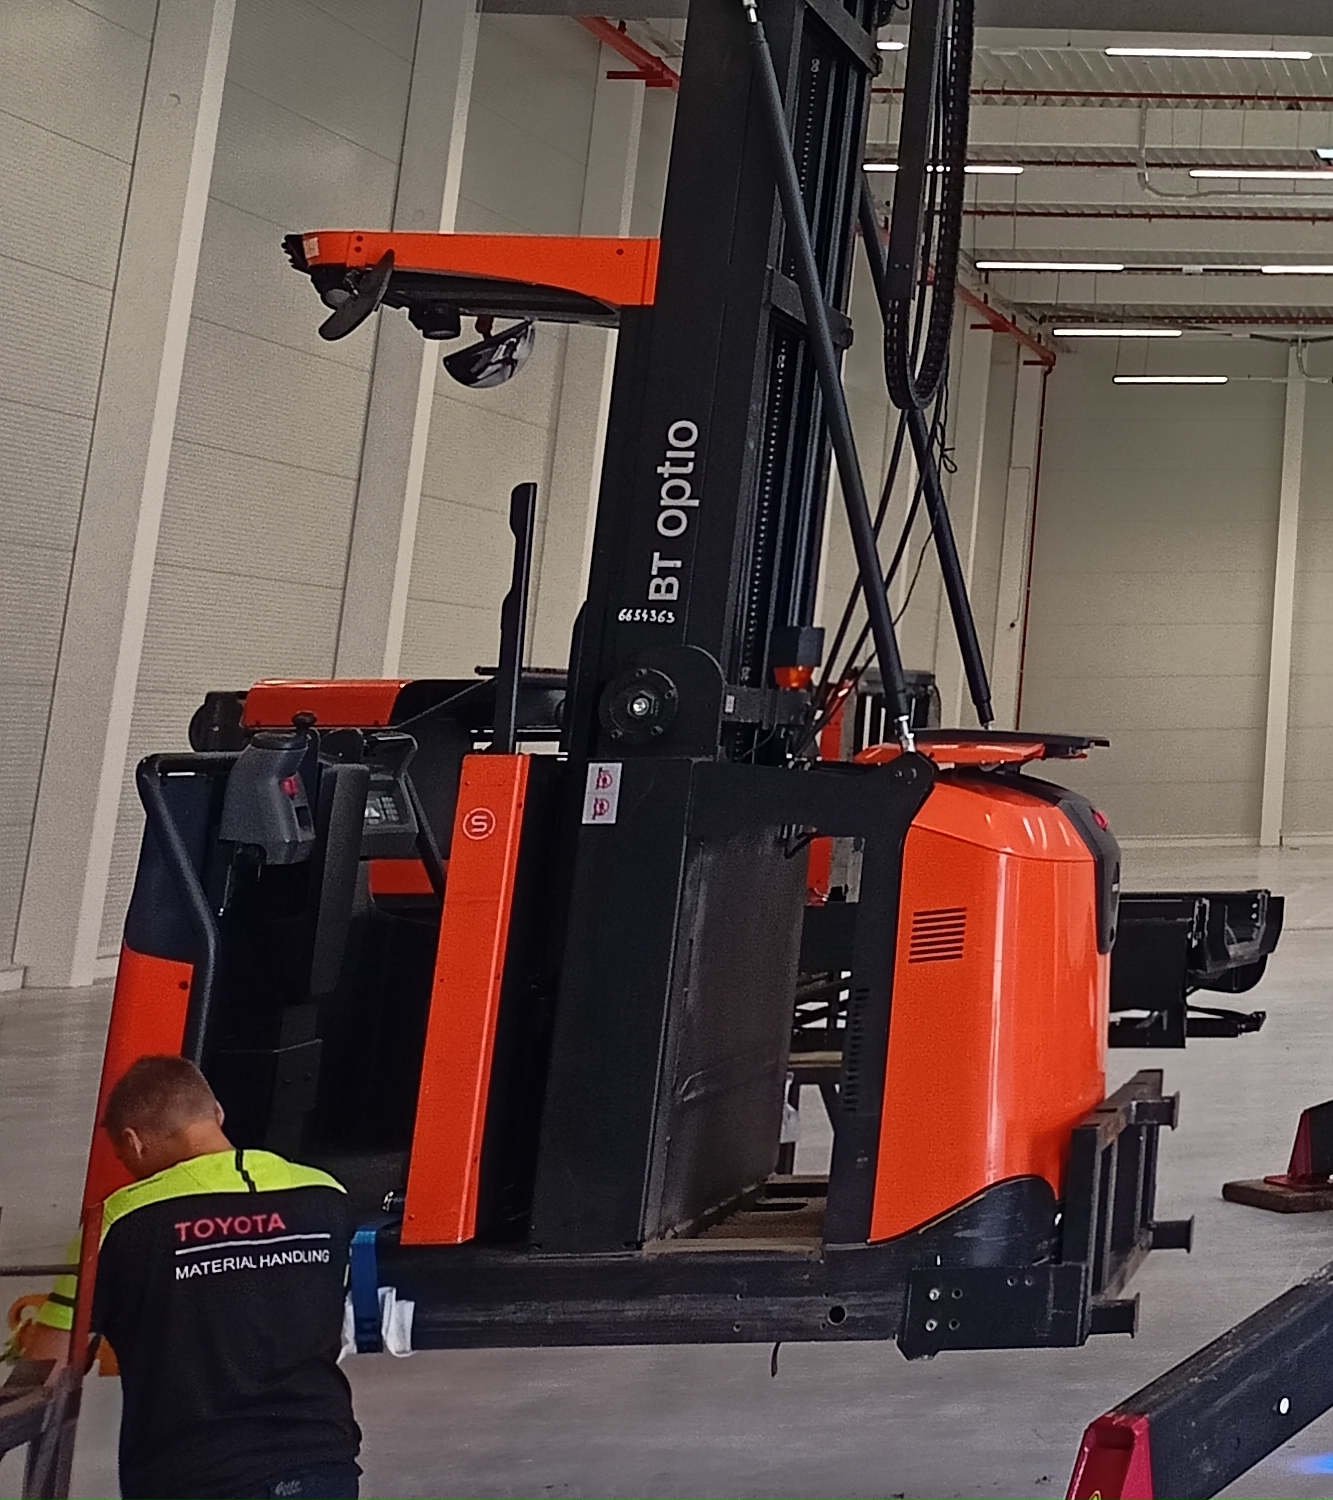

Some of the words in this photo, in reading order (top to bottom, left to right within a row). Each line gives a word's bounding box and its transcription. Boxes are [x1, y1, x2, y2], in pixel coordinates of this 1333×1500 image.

[656, 420, 700, 537] optio
[648, 552, 682, 600] BT
[618, 608, 676, 624] 6654363
[174, 1212, 286, 1242] TOYOTA
[175, 1255, 257, 1280] MATERIAL
[259, 1249, 330, 1269] HANDLING
